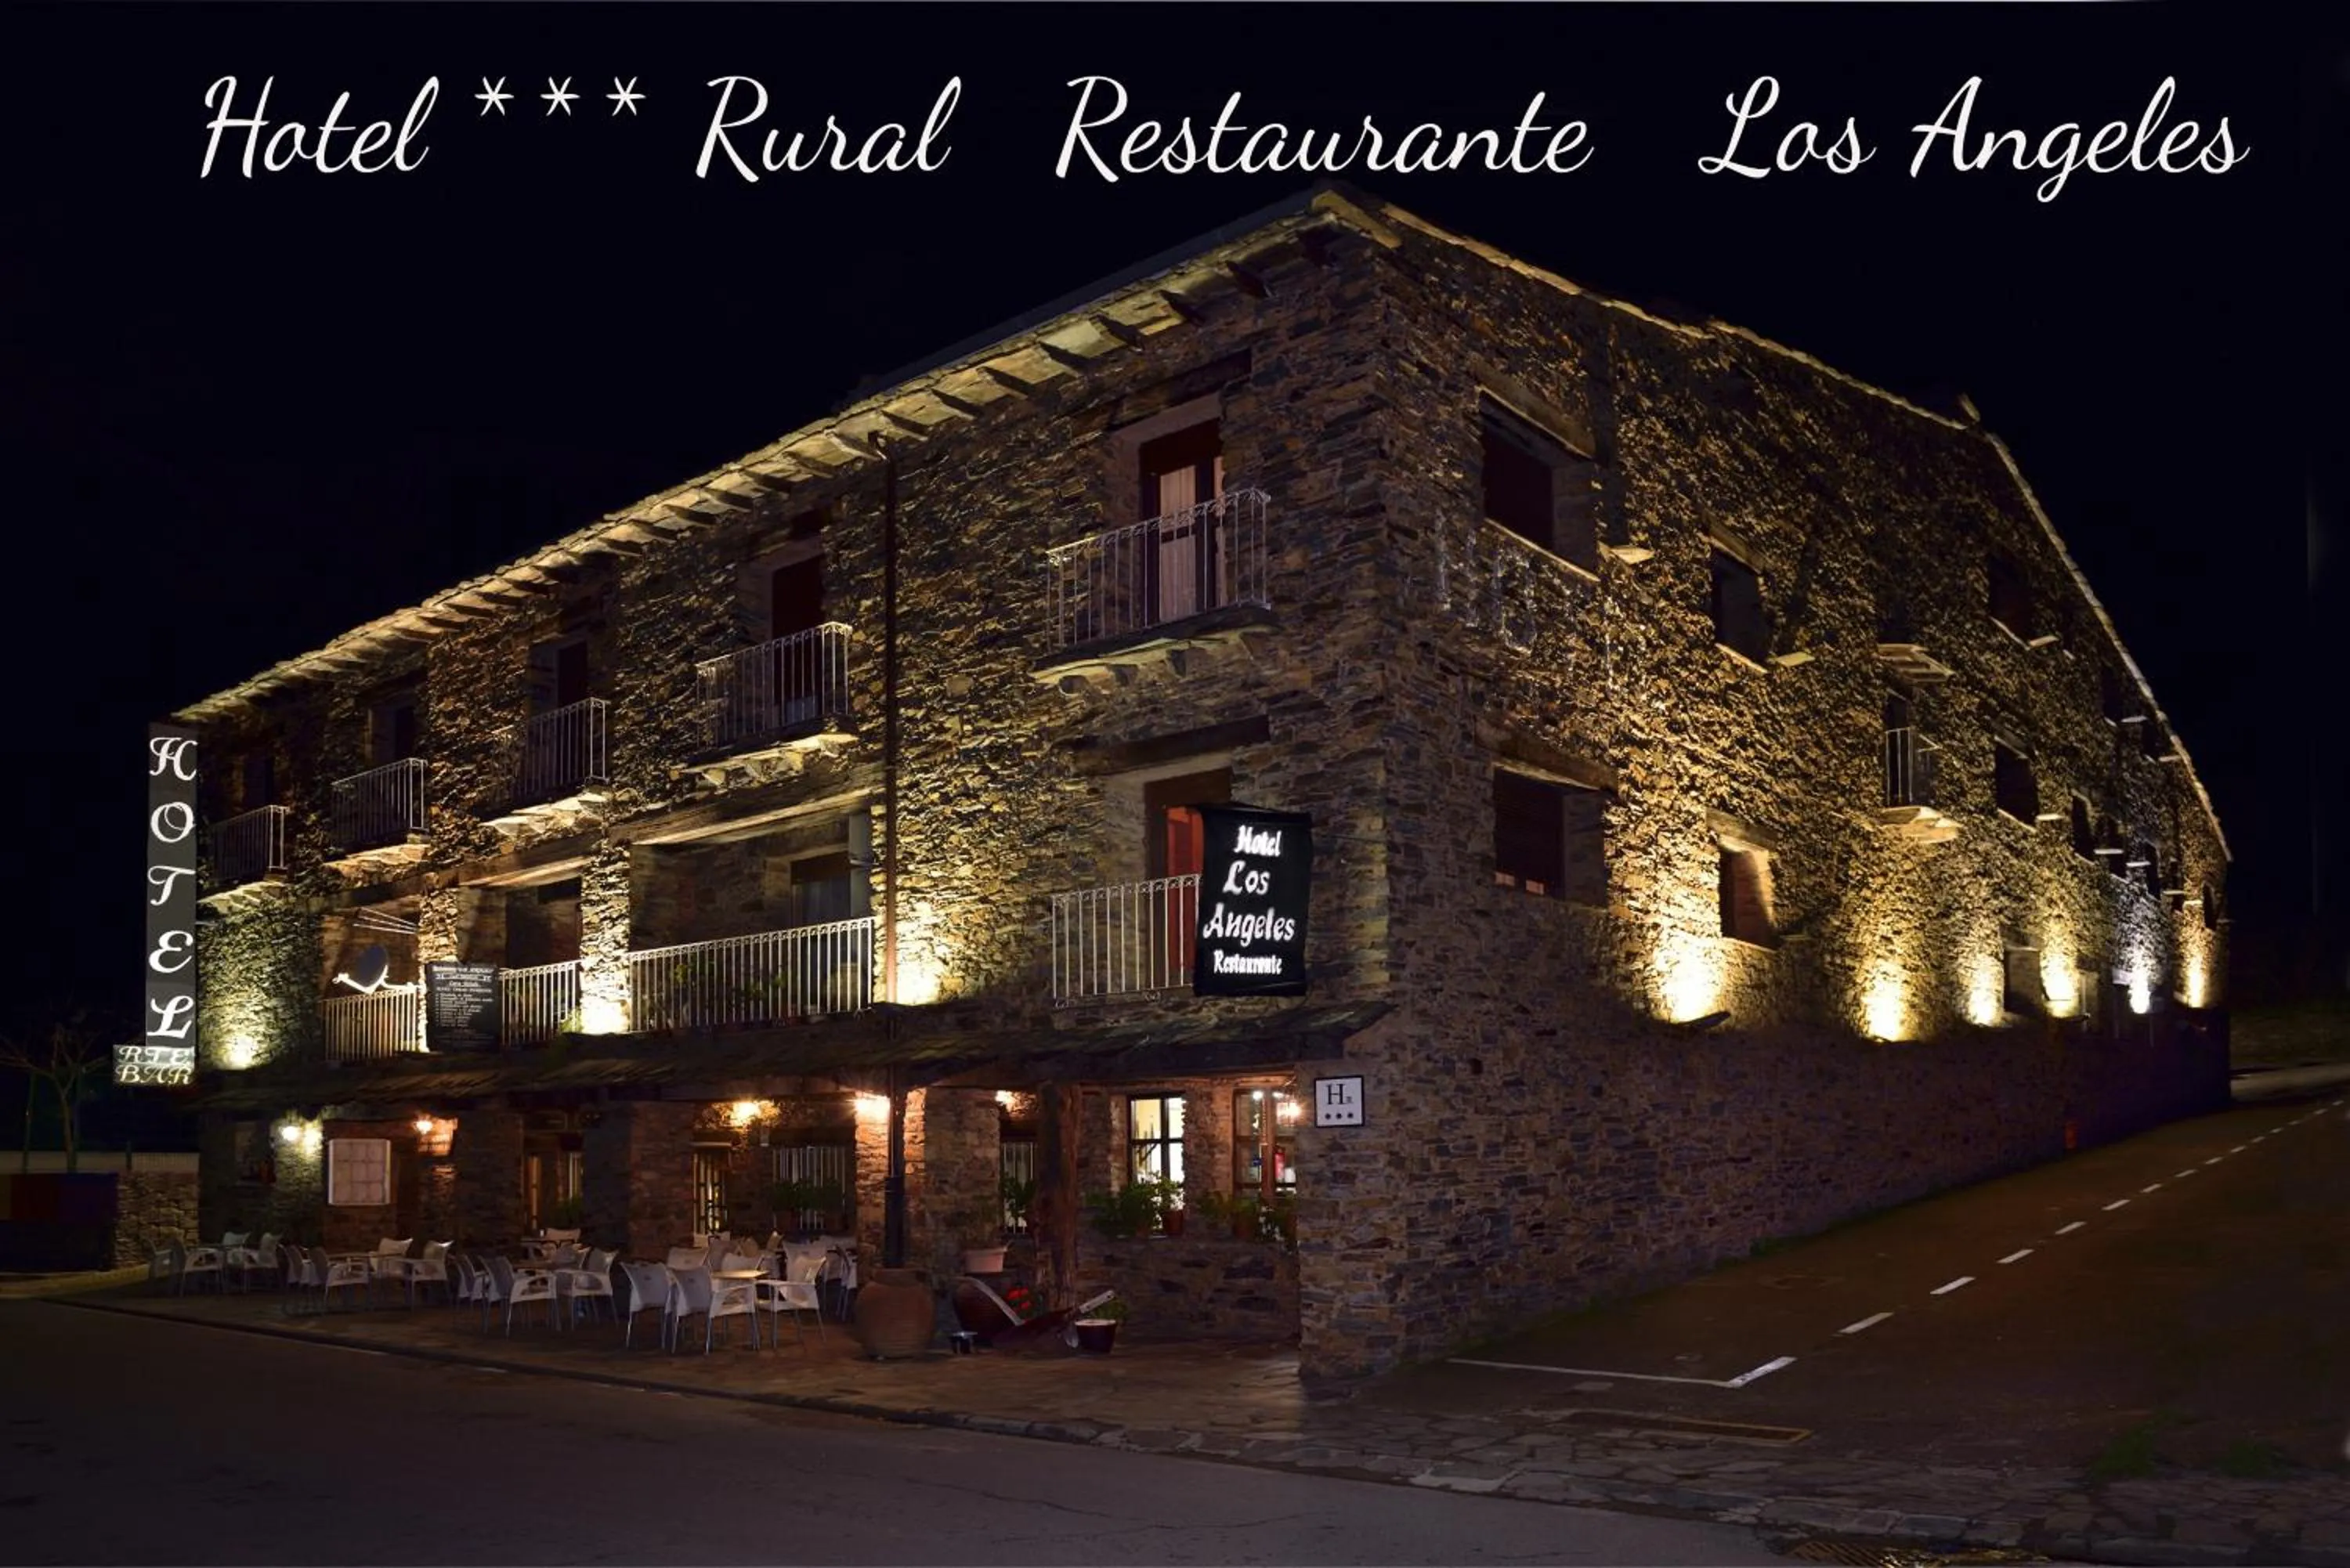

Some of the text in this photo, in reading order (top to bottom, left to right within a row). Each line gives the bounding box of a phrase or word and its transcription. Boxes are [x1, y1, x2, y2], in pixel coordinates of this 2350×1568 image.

[1233, 824, 1282, 857] Hotel
[146, 737, 197, 1039] HOTEL
[1222, 860, 1271, 895] Los
[1202, 902, 1295, 948] Angeles
[115, 1064, 192, 1085] BAR
